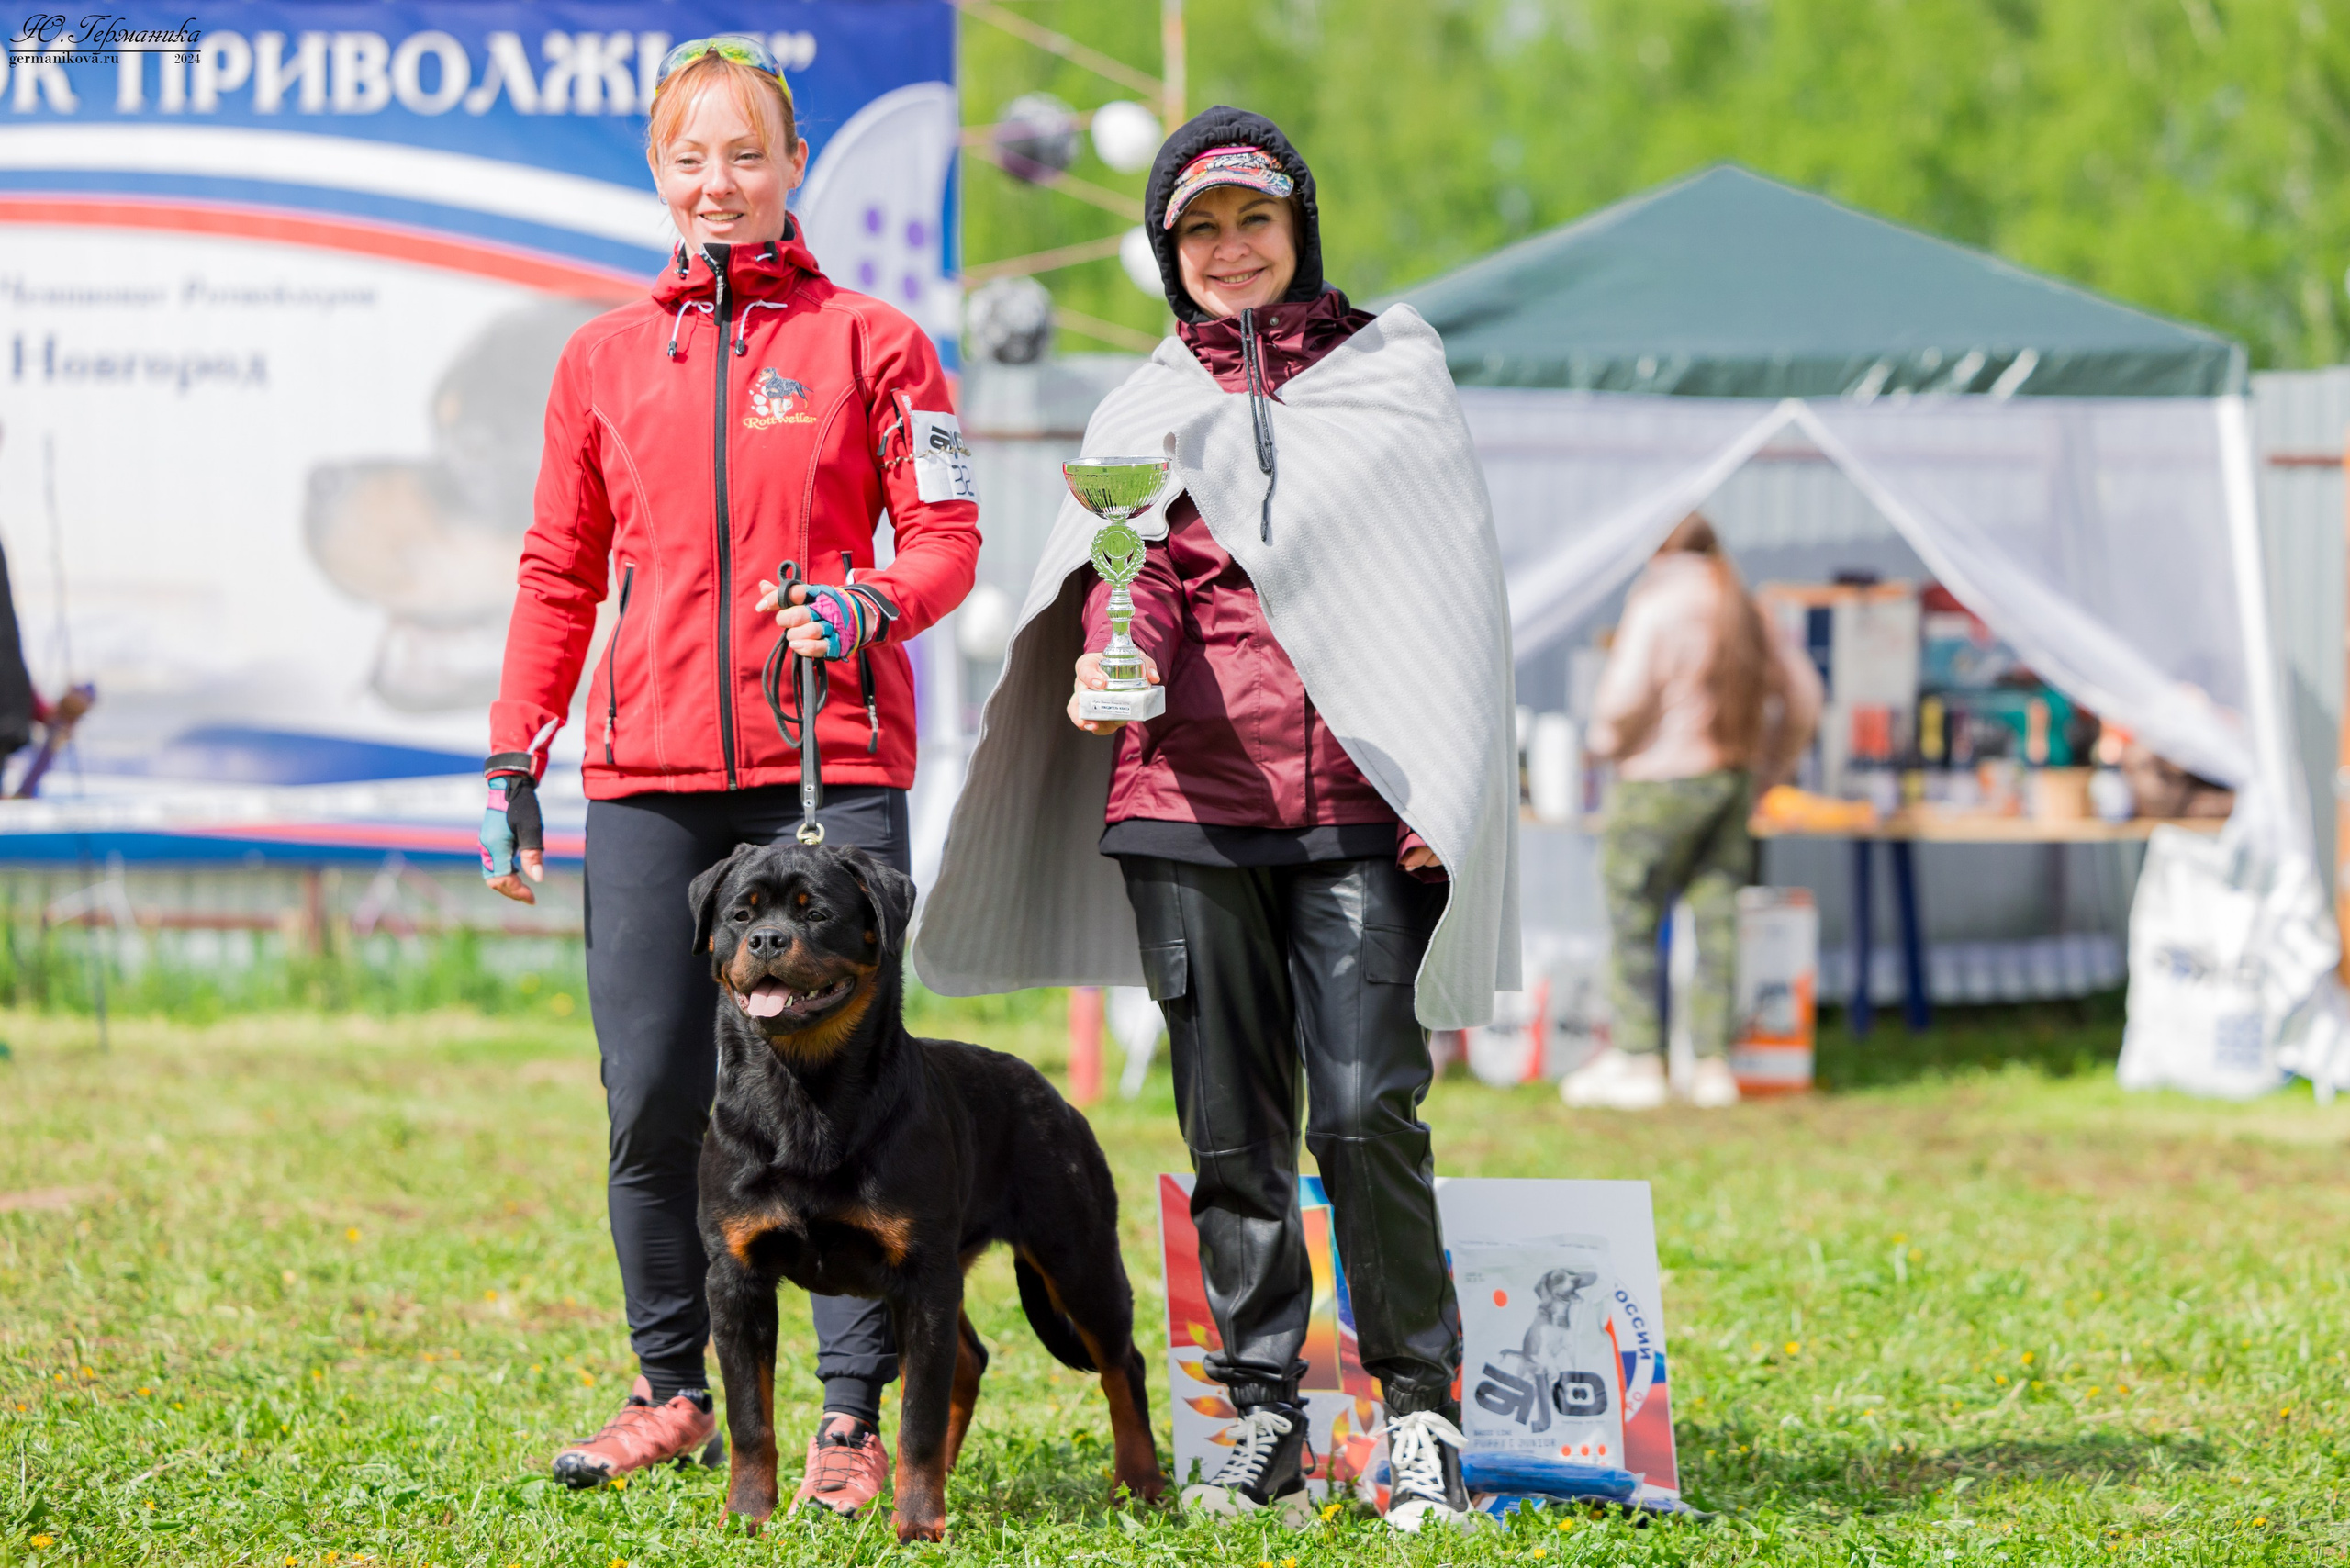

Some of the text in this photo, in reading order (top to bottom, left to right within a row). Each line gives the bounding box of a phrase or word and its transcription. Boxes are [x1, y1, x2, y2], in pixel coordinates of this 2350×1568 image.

[0, 30, 81, 117] К
[11, 331, 272, 394] Новгород
[743, 411, 817, 431] Rottweiler
[1614, 1282, 1651, 1361] ОССИИ
